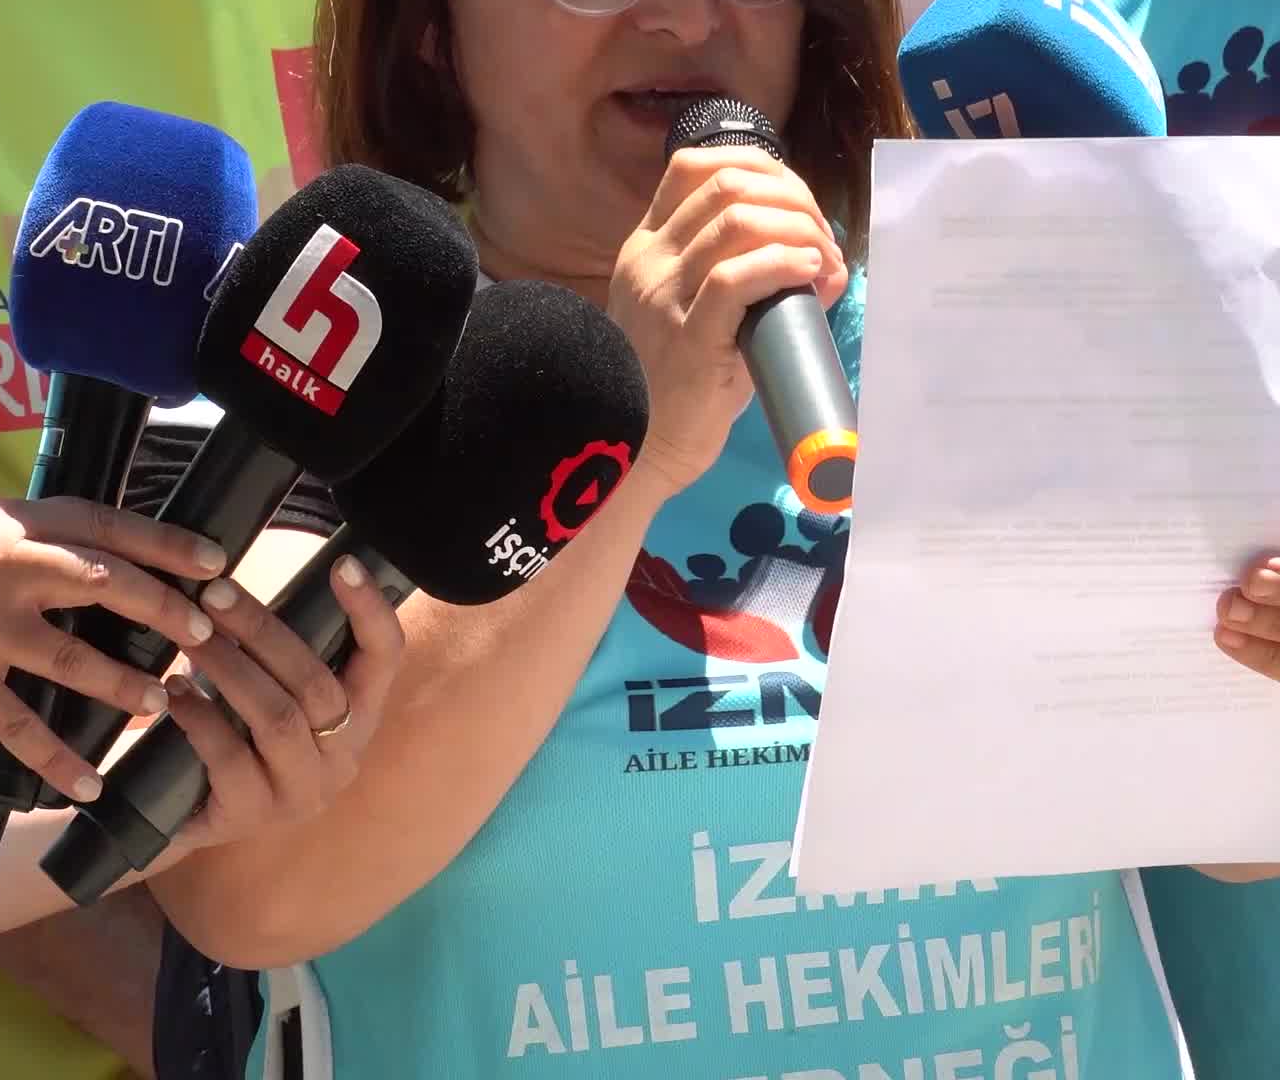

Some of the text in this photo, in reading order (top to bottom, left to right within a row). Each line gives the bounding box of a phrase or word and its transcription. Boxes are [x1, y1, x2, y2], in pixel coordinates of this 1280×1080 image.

[258, 346, 321, 402] halk
[624, 748, 697, 773] AİLE
[507, 959, 698, 1058] AİLE
[722, 892, 1103, 1035] HEKİMLERİ
